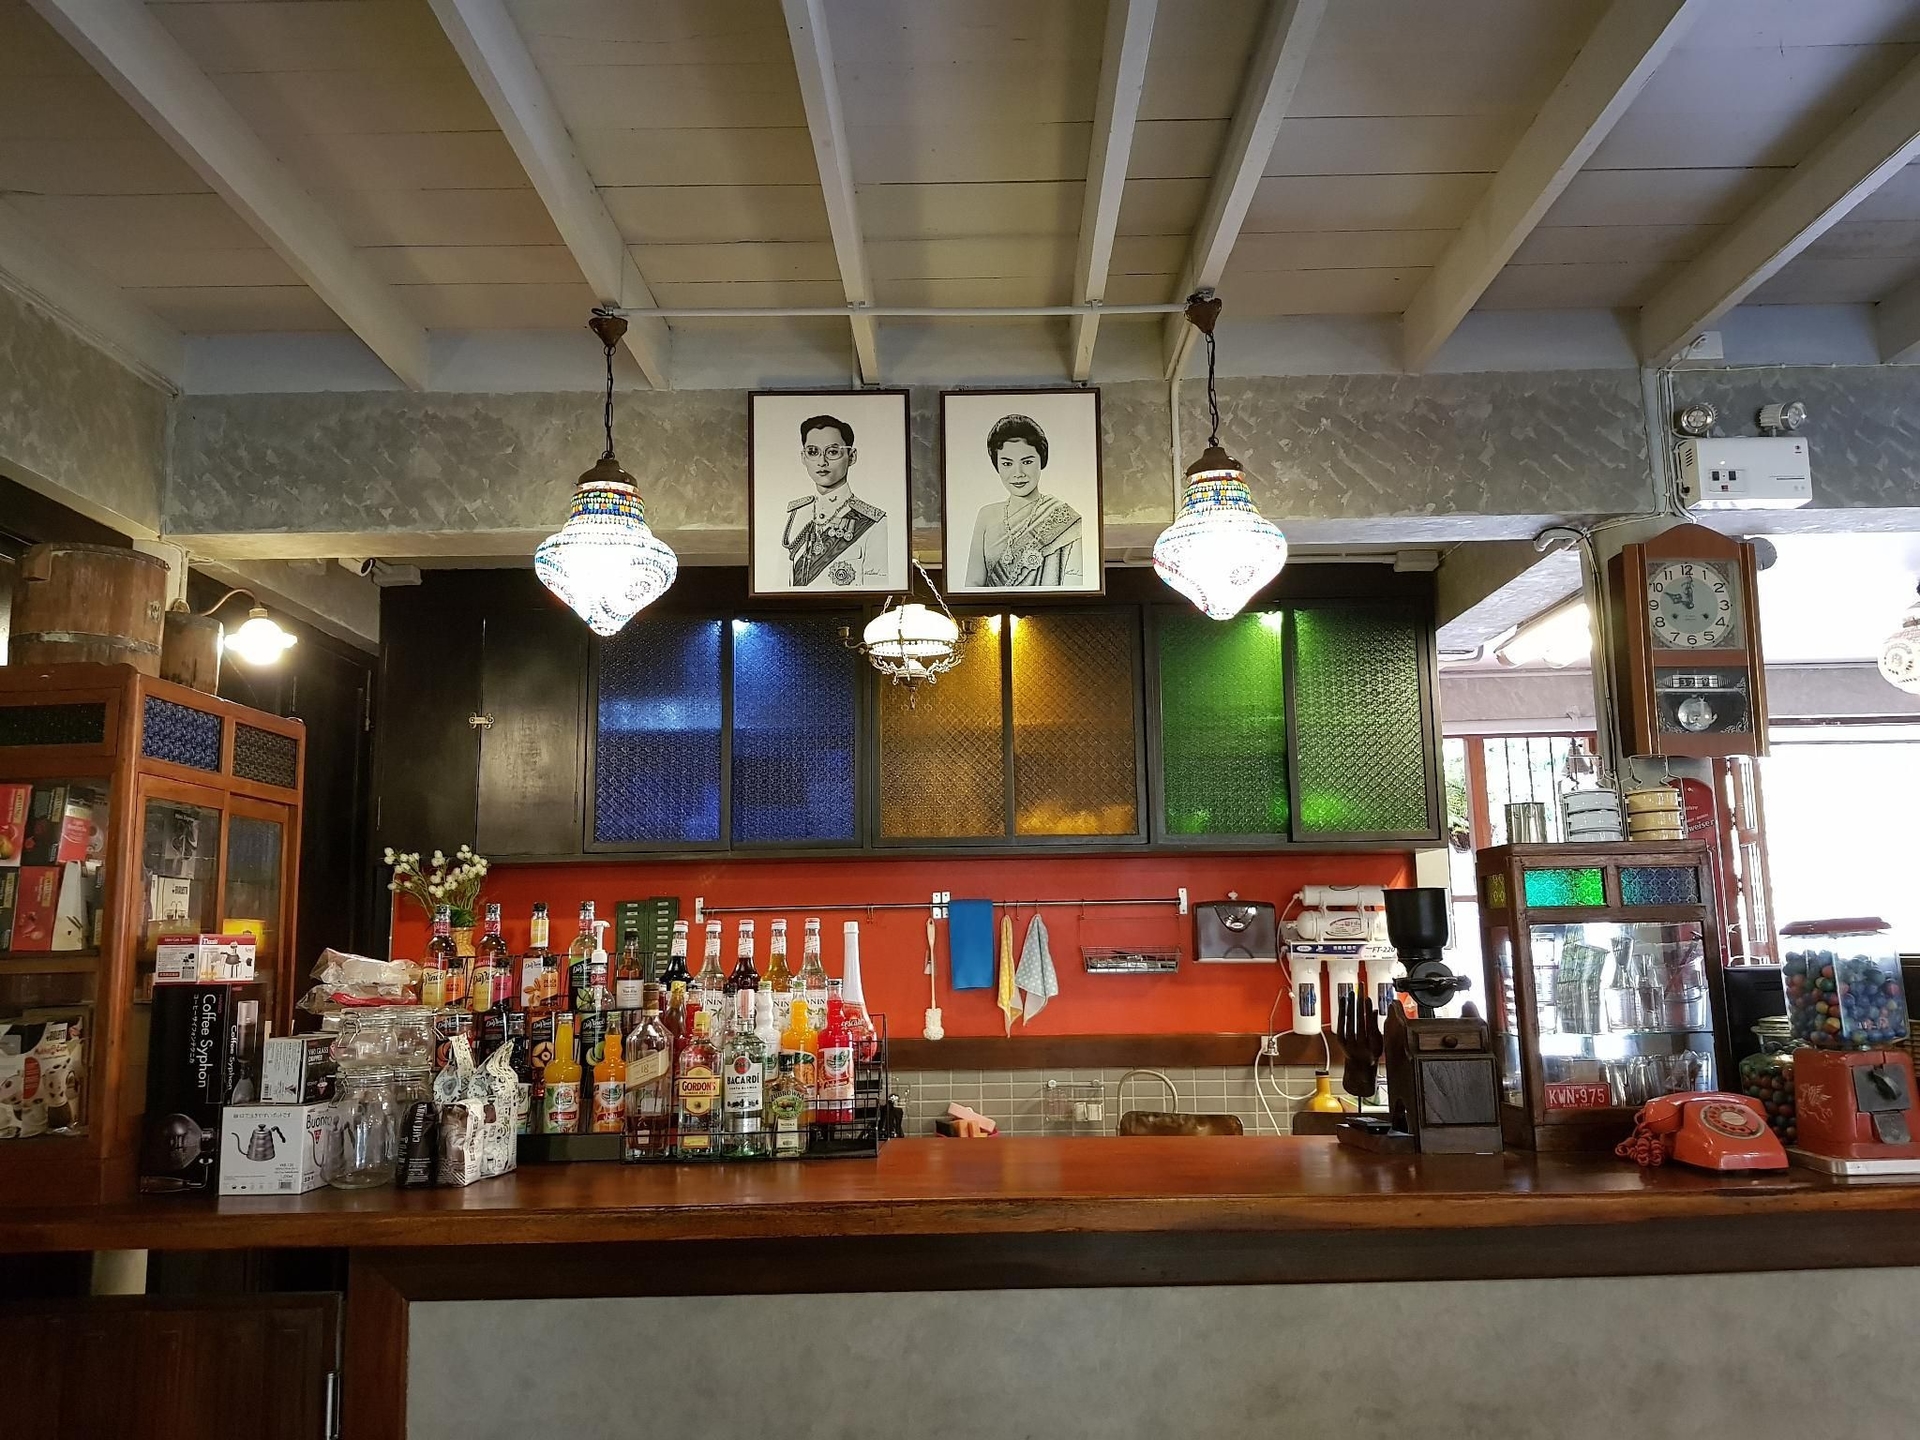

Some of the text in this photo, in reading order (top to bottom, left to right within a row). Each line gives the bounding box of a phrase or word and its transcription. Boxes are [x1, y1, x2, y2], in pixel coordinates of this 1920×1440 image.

[1664, 570, 1673, 580] 11
[1680, 564, 1693, 576] 12
[1702, 570, 1707, 580] 1
[1652, 582, 1664, 593] 10
[1713, 582, 1725, 593] 2
[1649, 599, 1659, 611] 9
[1719, 599, 1730, 611] 3
[1654, 616, 1666, 628] 8
[1715, 616, 1726, 627] 4
[1670, 632, 1681, 642] 7
[1687, 634, 1698, 645] 6
[1703, 631, 1715, 641] 5
[1688, 819, 1715, 833] weiser
[196, 994, 217, 1088] Coffee Syphon
[227, 1024, 238, 1090] Coffee Syphon
